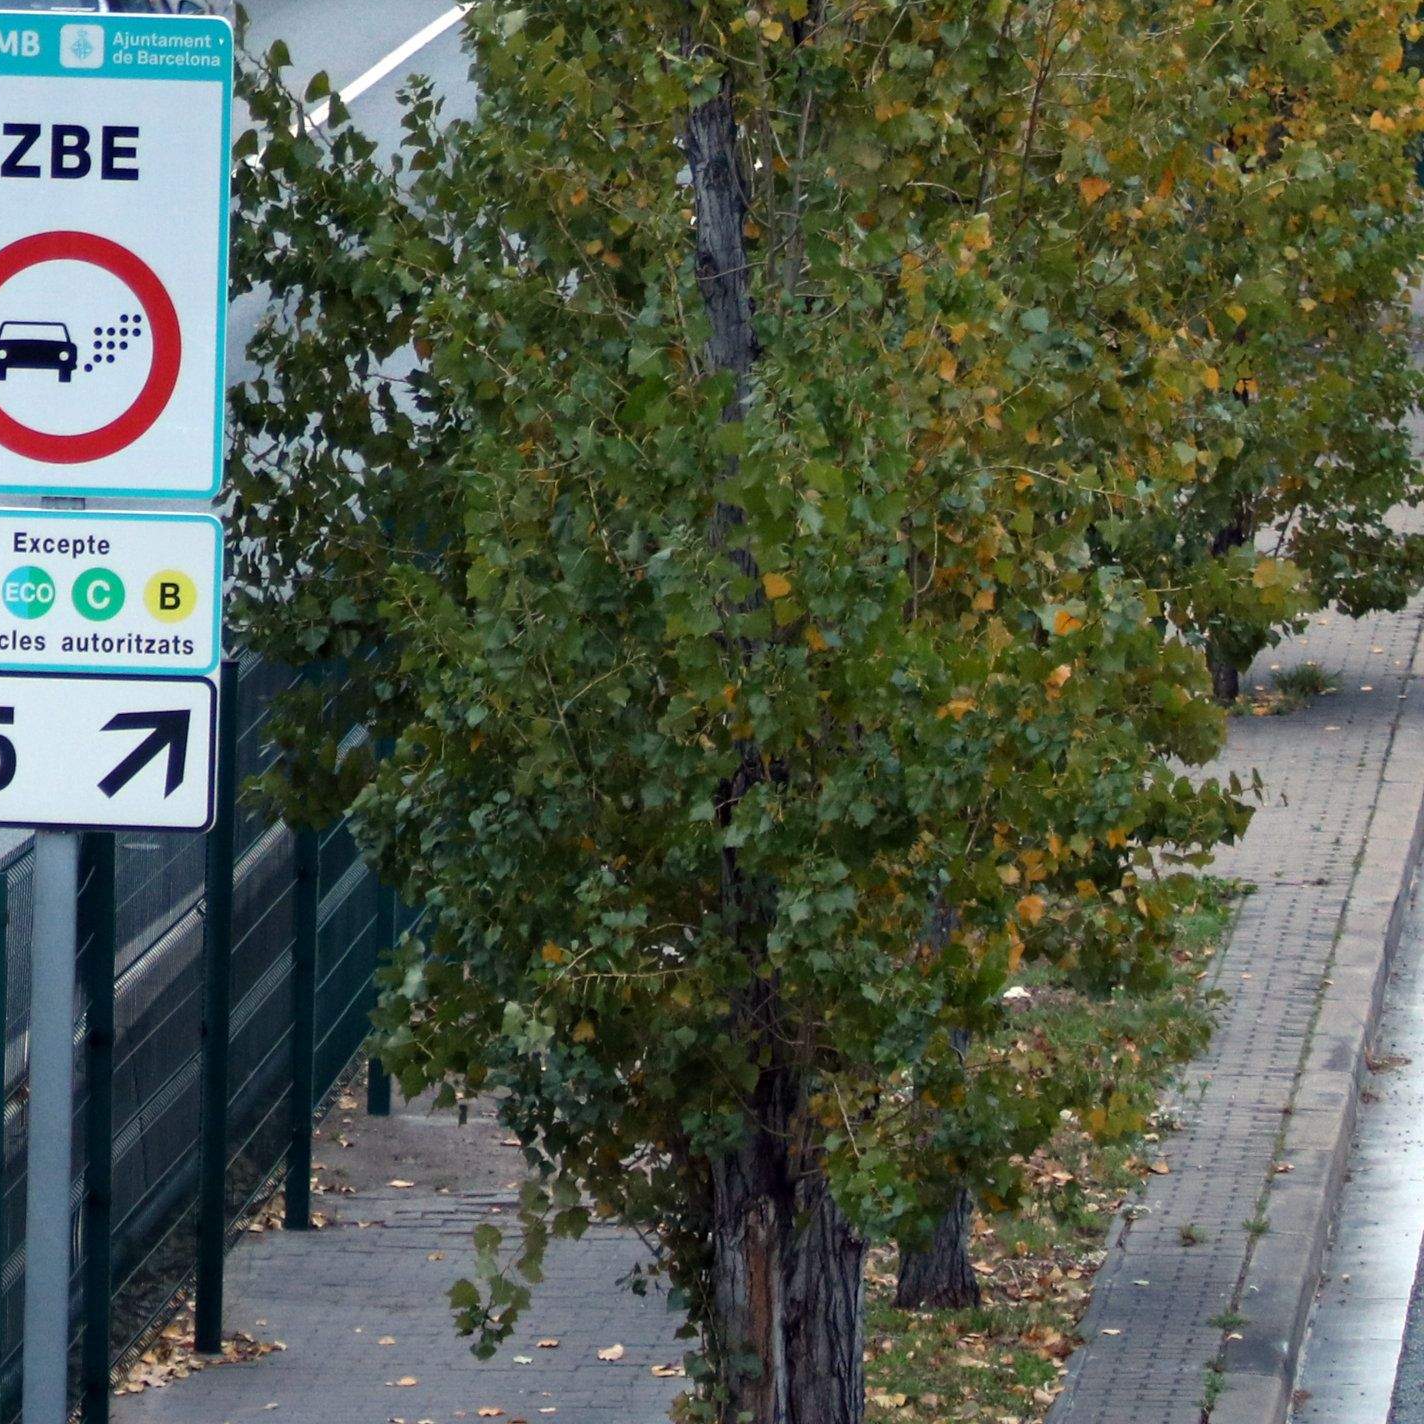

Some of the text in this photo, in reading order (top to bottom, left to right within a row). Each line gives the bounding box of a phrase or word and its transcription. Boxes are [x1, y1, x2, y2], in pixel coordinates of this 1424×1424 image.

[112, 32, 211, 50] Ajuntament
[112, 50, 221, 67] de Barcelona
[0, 123, 139, 180] ZBE
[13, 532, 111, 559] Excepte
[4, 581, 54, 604] ECO
[86, 580, 111, 609] C
[159, 582, 181, 610] B
[61, 634, 194, 655] autoritzats
